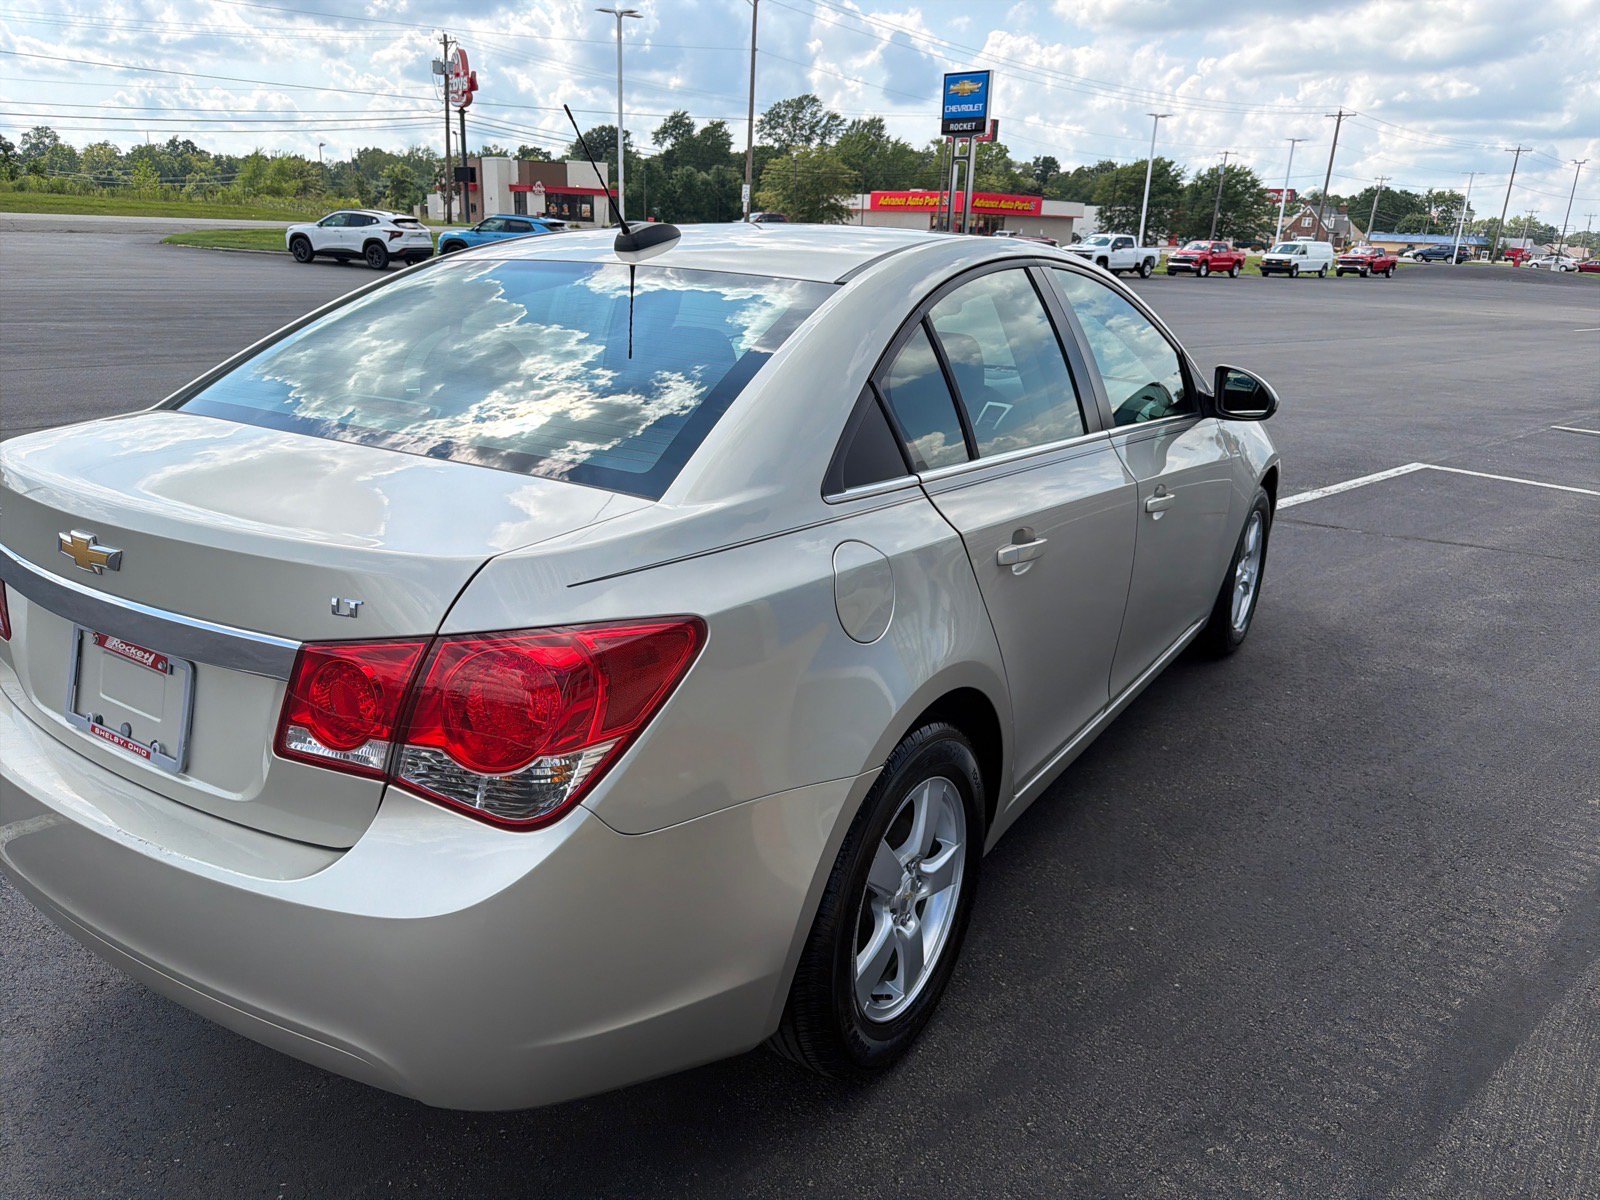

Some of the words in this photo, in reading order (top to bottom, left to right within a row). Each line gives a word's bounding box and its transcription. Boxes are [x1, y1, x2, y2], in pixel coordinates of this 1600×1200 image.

[945, 104, 983, 113] CHEVROLET
[950, 122, 976, 131] ROCKET
[879, 196, 906, 206] Advance
[906, 196, 924, 206] Auto
[924, 196, 942, 206] Part
[973, 198, 999, 208] Advance
[999, 200, 1014, 209] Auto
[1013, 201, 1031, 210] Parts
[331, 597, 364, 618] LT
[111, 638, 150, 660] Rocket
[127, 742, 147, 757] OHIO
